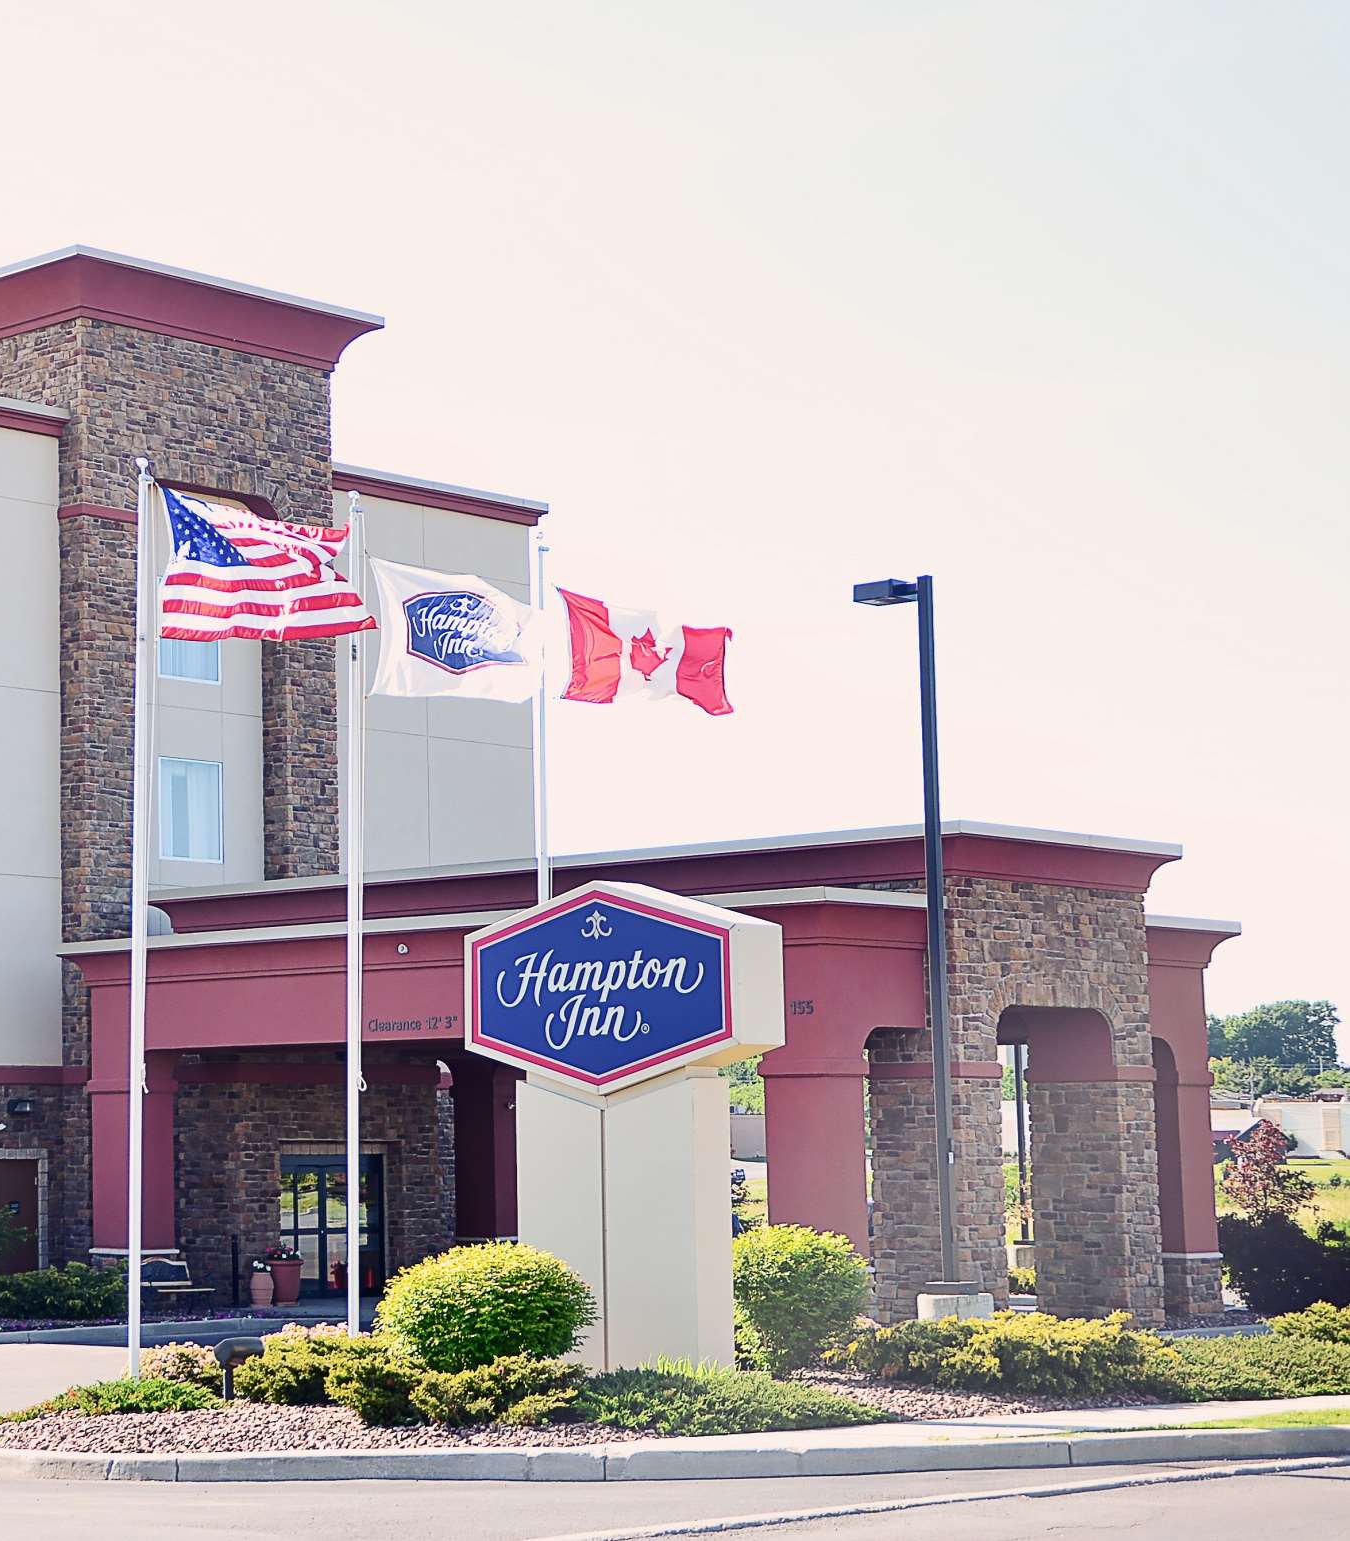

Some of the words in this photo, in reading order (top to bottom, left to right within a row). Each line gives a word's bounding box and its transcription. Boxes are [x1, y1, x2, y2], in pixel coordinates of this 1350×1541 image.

[433, 631, 484, 661] Inn
[496, 948, 704, 1008] Hampton
[790, 1000, 814, 1015] 155
[368, 1018, 422, 1032] Clearance
